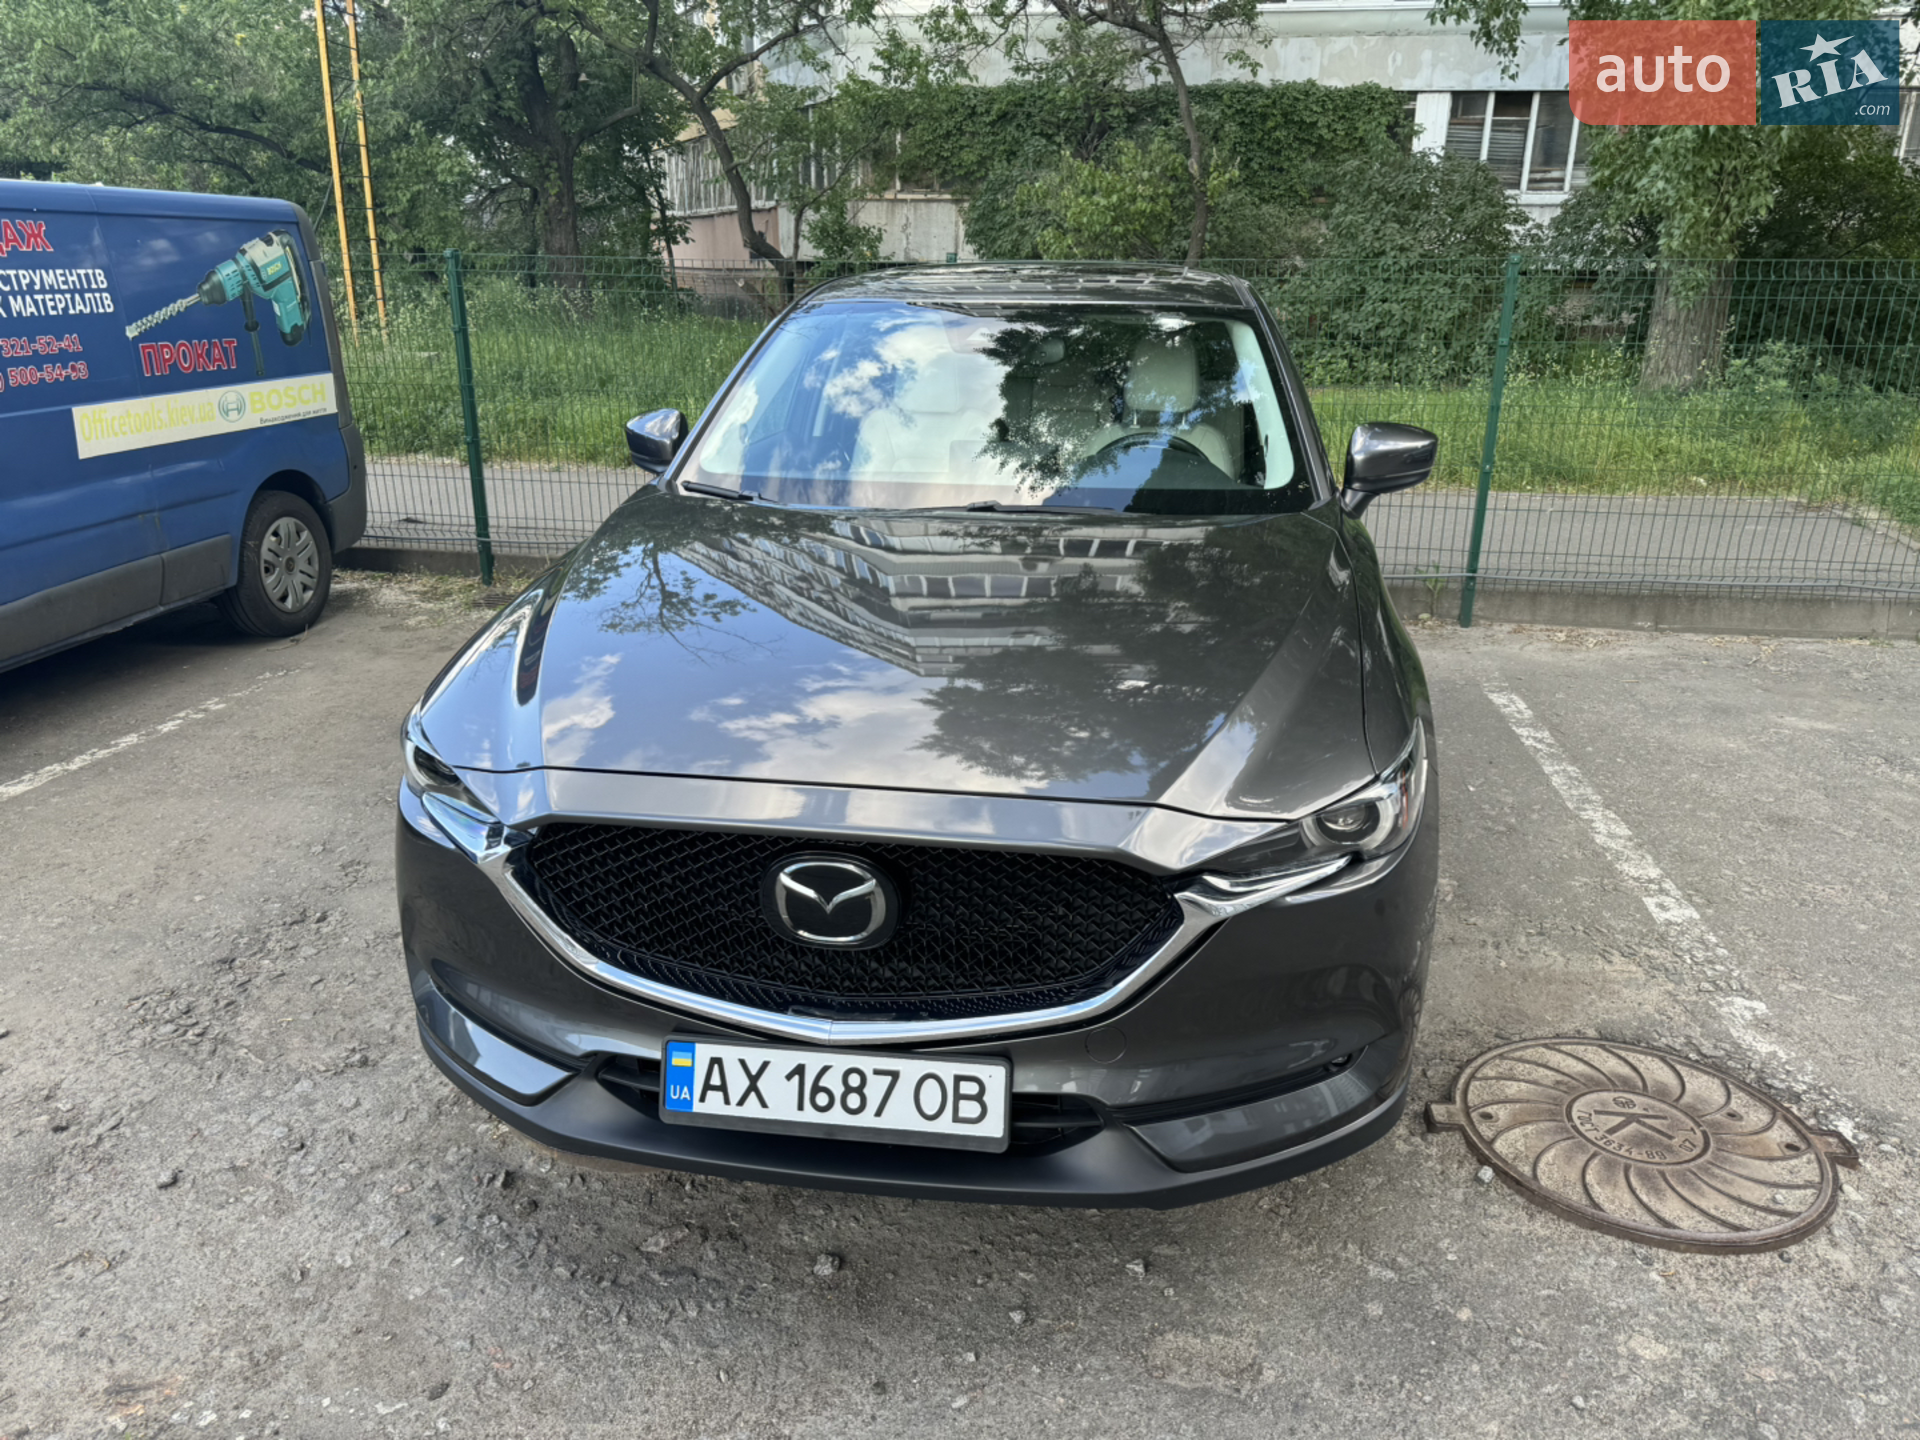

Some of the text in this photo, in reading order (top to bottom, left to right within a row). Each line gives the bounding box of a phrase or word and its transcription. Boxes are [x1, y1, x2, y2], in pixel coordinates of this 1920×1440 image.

[0, 219, 54, 257] АЖ
[8, 292, 115, 317] МАТЕРІАЛІВ
[0, 333, 83, 358] 321-52-41
[139, 338, 237, 376] ПРОКАТ
[7, 361, 88, 387] 500-54-93
[249, 381, 327, 414] BOSCH
[79, 399, 217, 443] Officetools.kiev.ua
[670, 1084, 691, 1101] UA
[699, 1056, 988, 1125] AX 1687 OB
